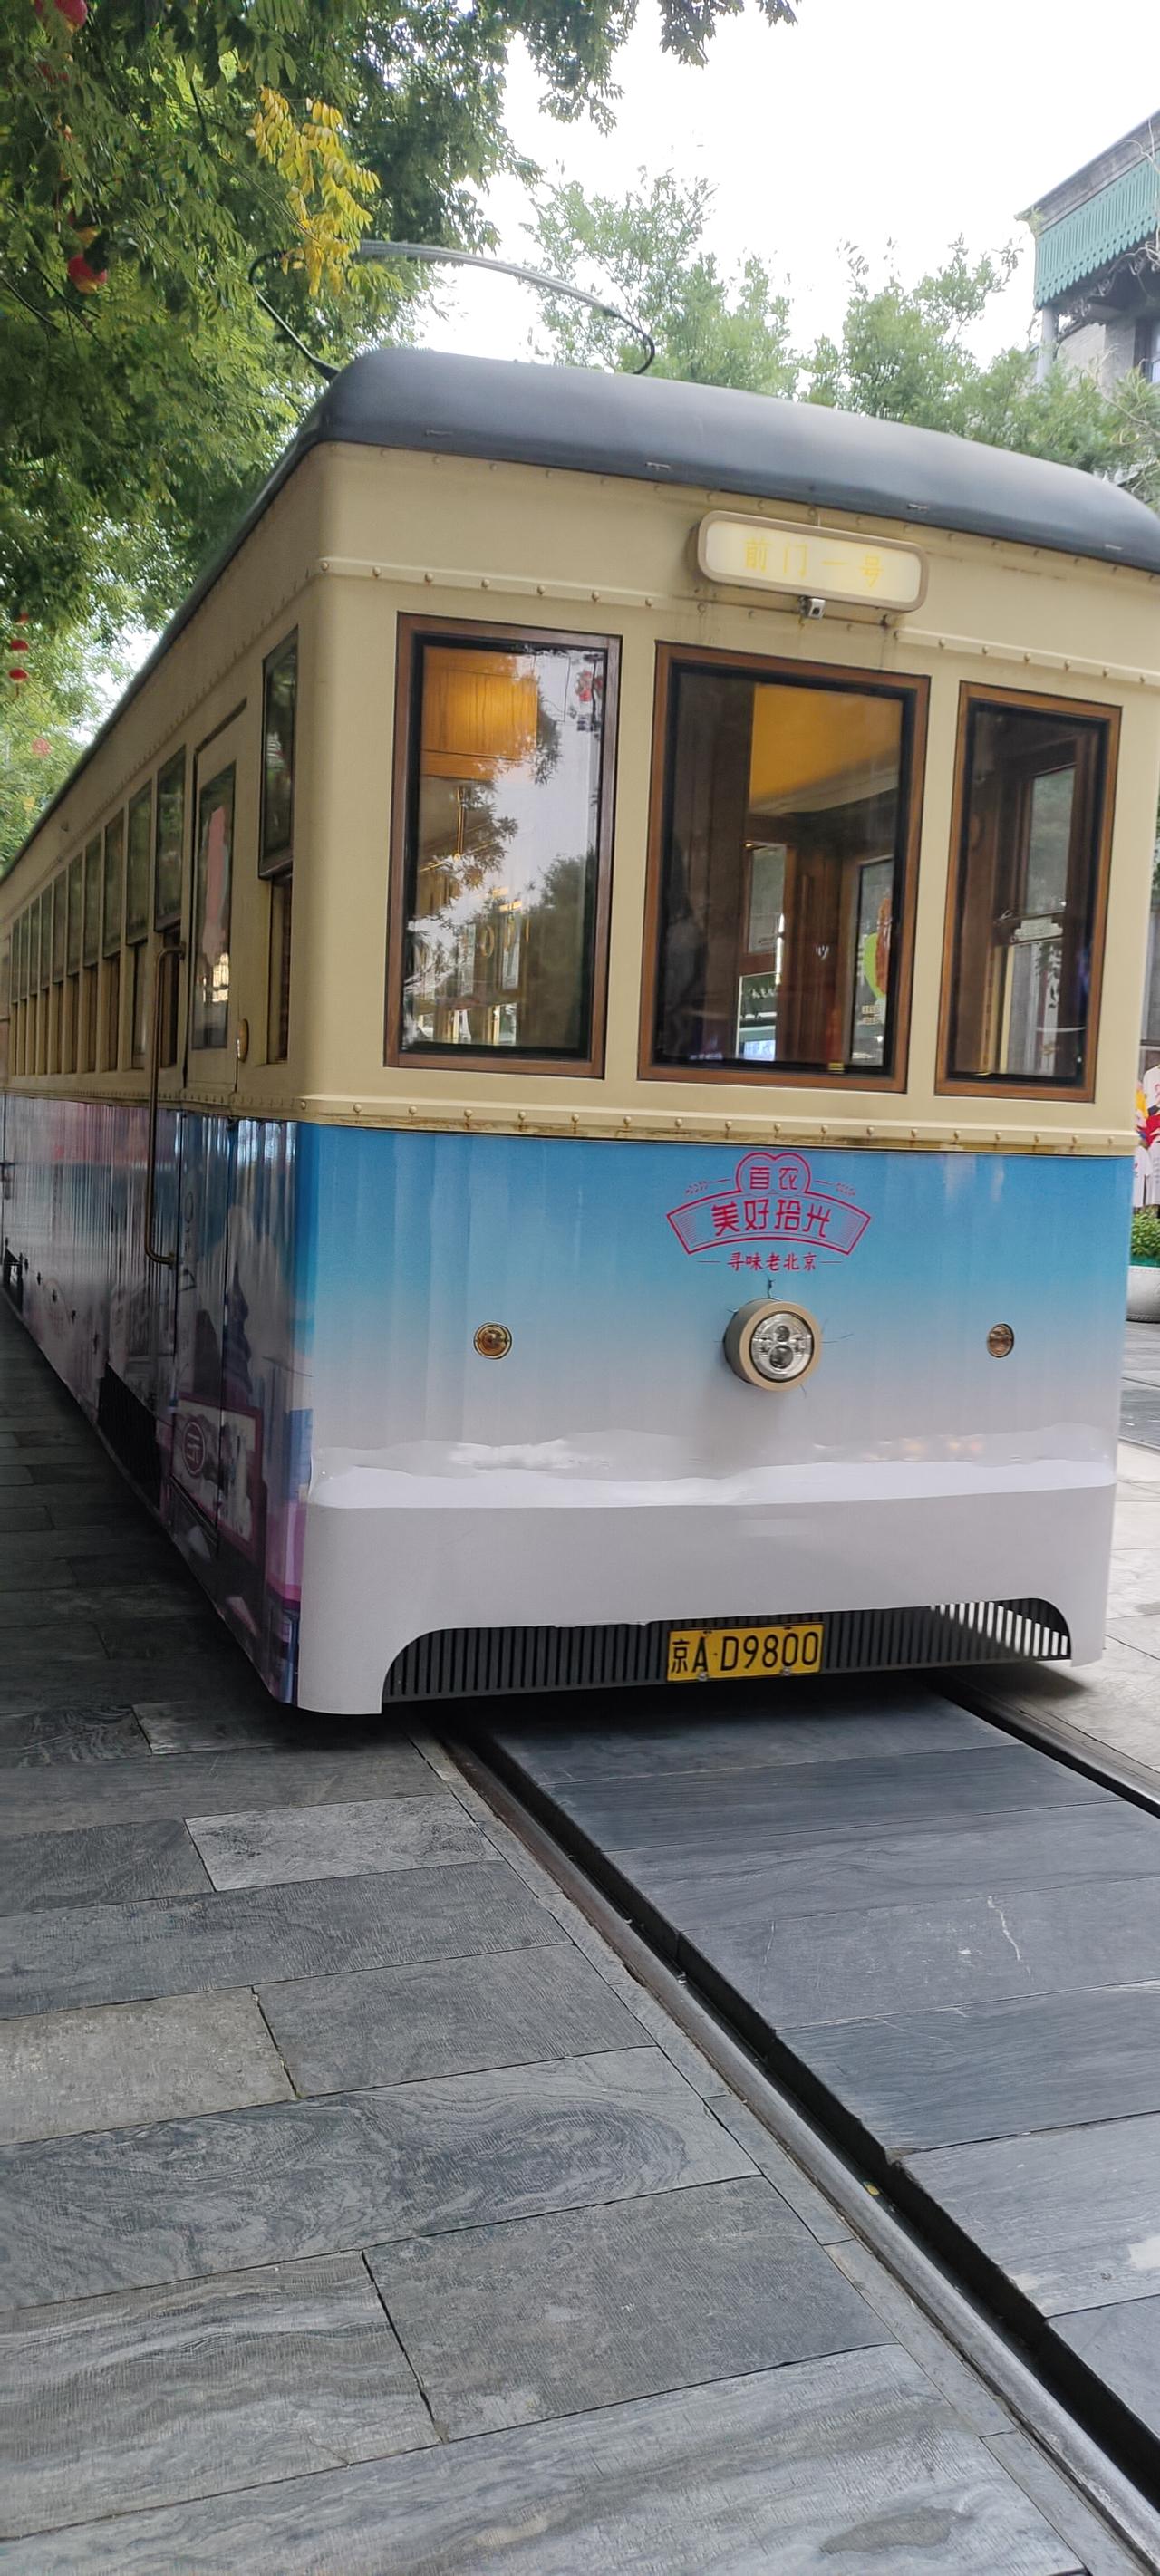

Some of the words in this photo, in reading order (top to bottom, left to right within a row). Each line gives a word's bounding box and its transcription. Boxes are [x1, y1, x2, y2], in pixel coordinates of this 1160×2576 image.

[743, 536, 884, 587] 前门一号
[749, 1166, 798, 1191] 首农
[710, 1198, 832, 1239] 美好拾光
[727, 1251, 817, 1272] 寻味老北京
